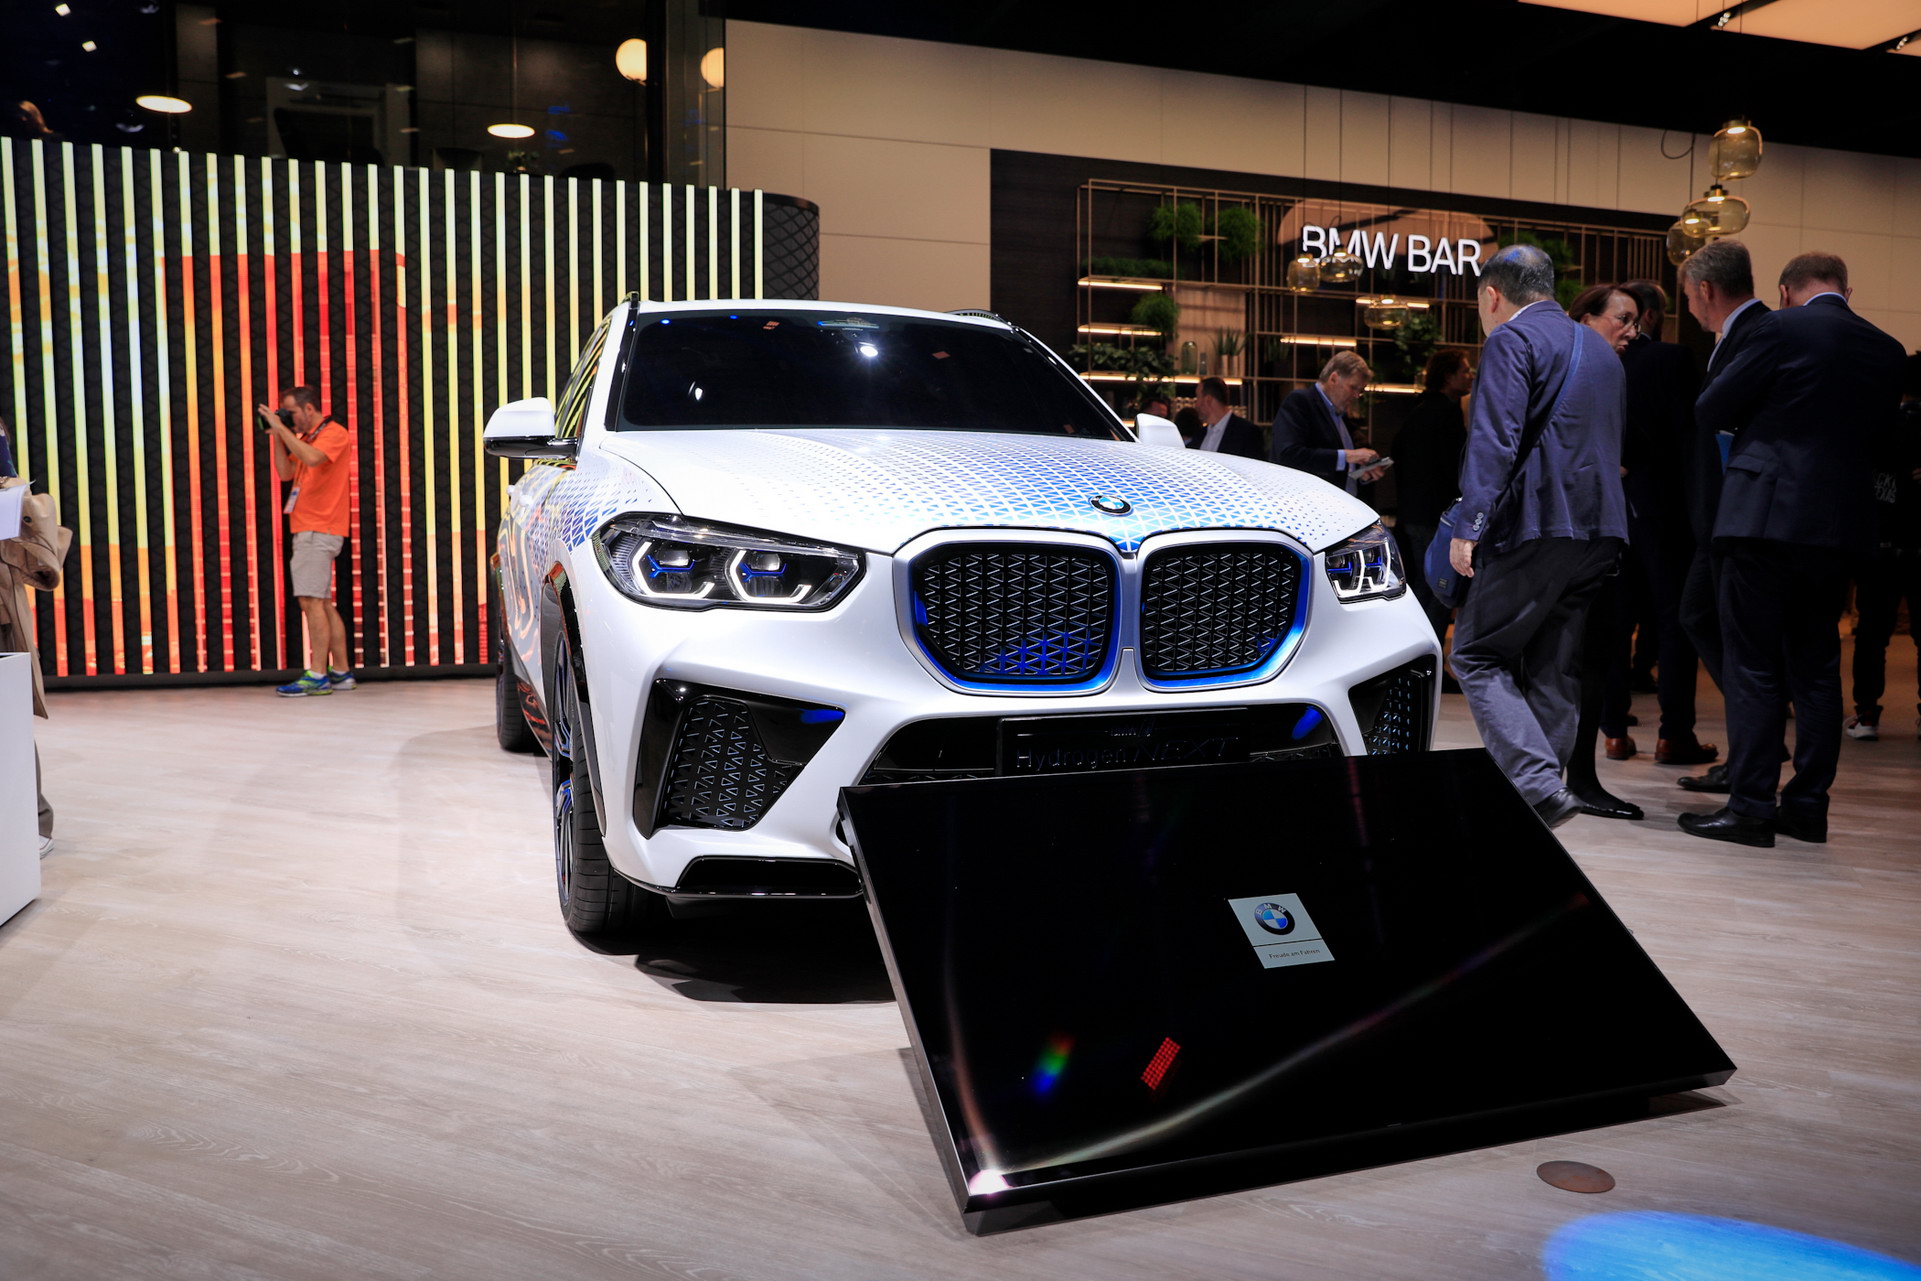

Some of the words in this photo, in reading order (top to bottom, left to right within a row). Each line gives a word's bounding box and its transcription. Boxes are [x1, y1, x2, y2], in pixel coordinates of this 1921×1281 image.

[1302, 225, 1399, 270] BMW
[1407, 234, 1481, 276] BAR
[1016, 747, 1126, 771] Hydrogen
[1133, 735, 1239, 761] NEXT
[1256, 903, 1286, 915] BMW
